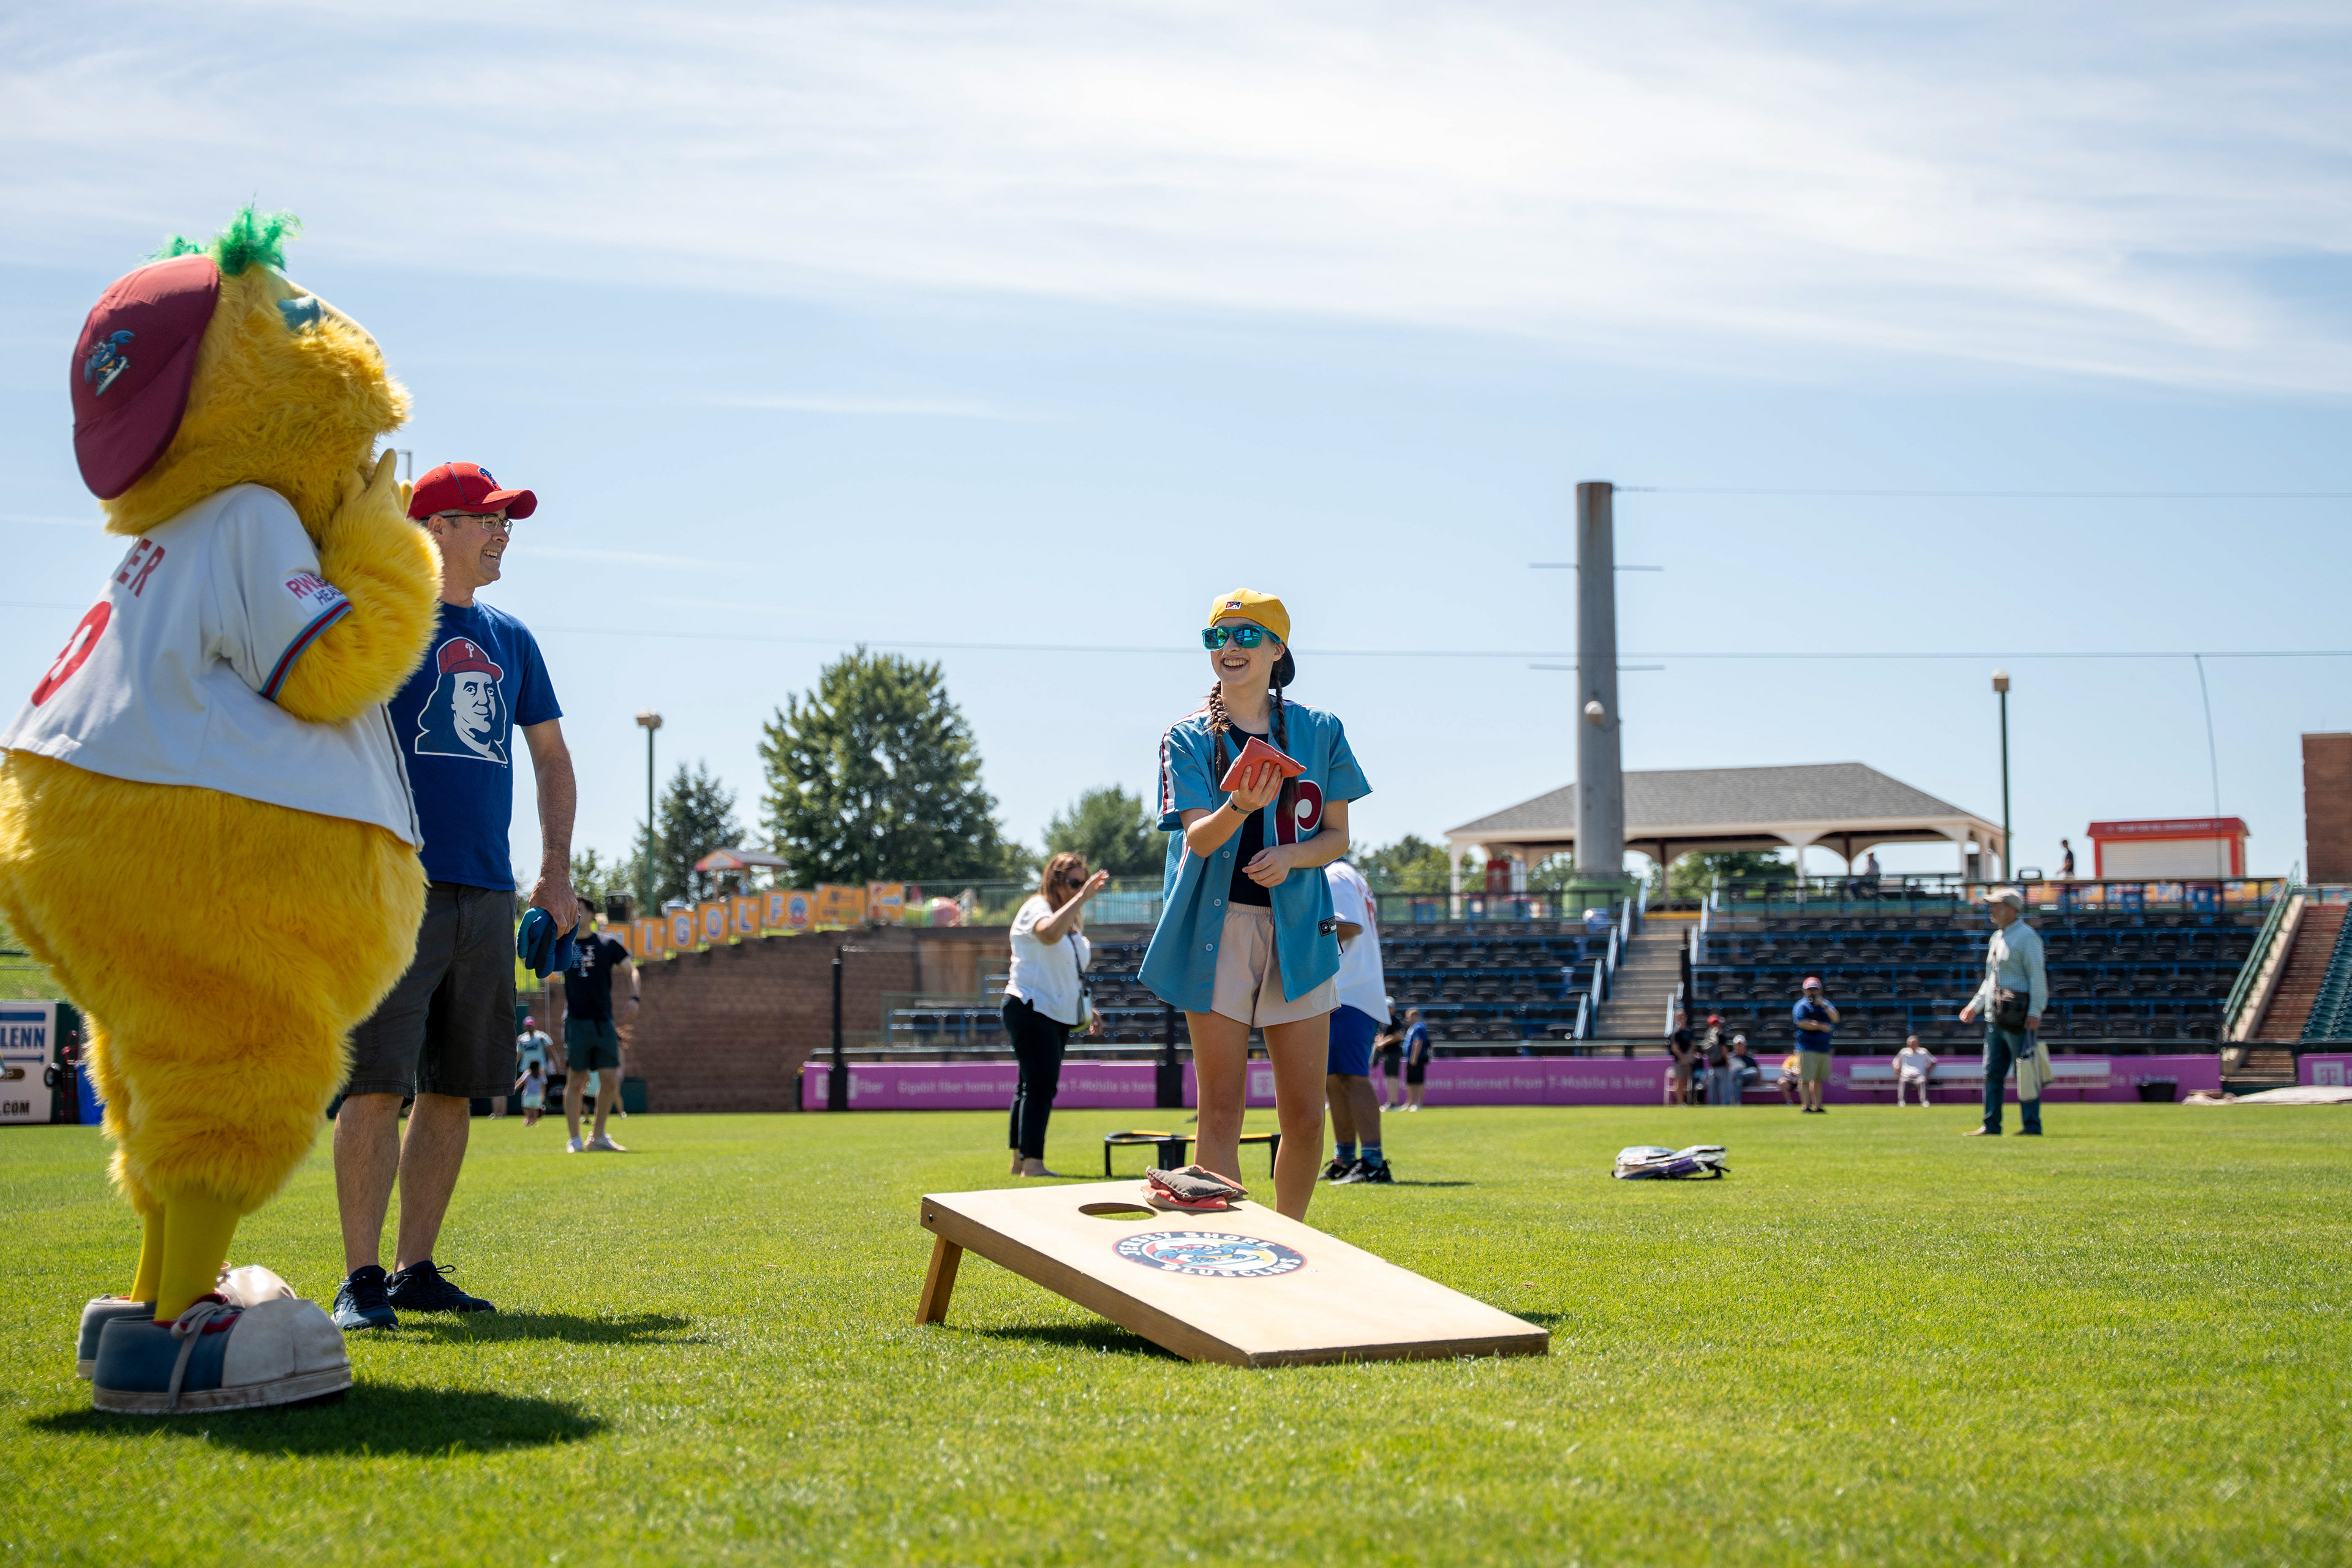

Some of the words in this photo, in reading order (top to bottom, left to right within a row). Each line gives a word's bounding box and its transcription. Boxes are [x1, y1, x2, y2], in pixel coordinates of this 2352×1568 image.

[465, 643, 474, 658] P
[1118, 1232, 1172, 1256] JERSEY
[1183, 1232, 1276, 1248] SHORE
[1161, 1257, 1301, 1278] BLUECLAWS
